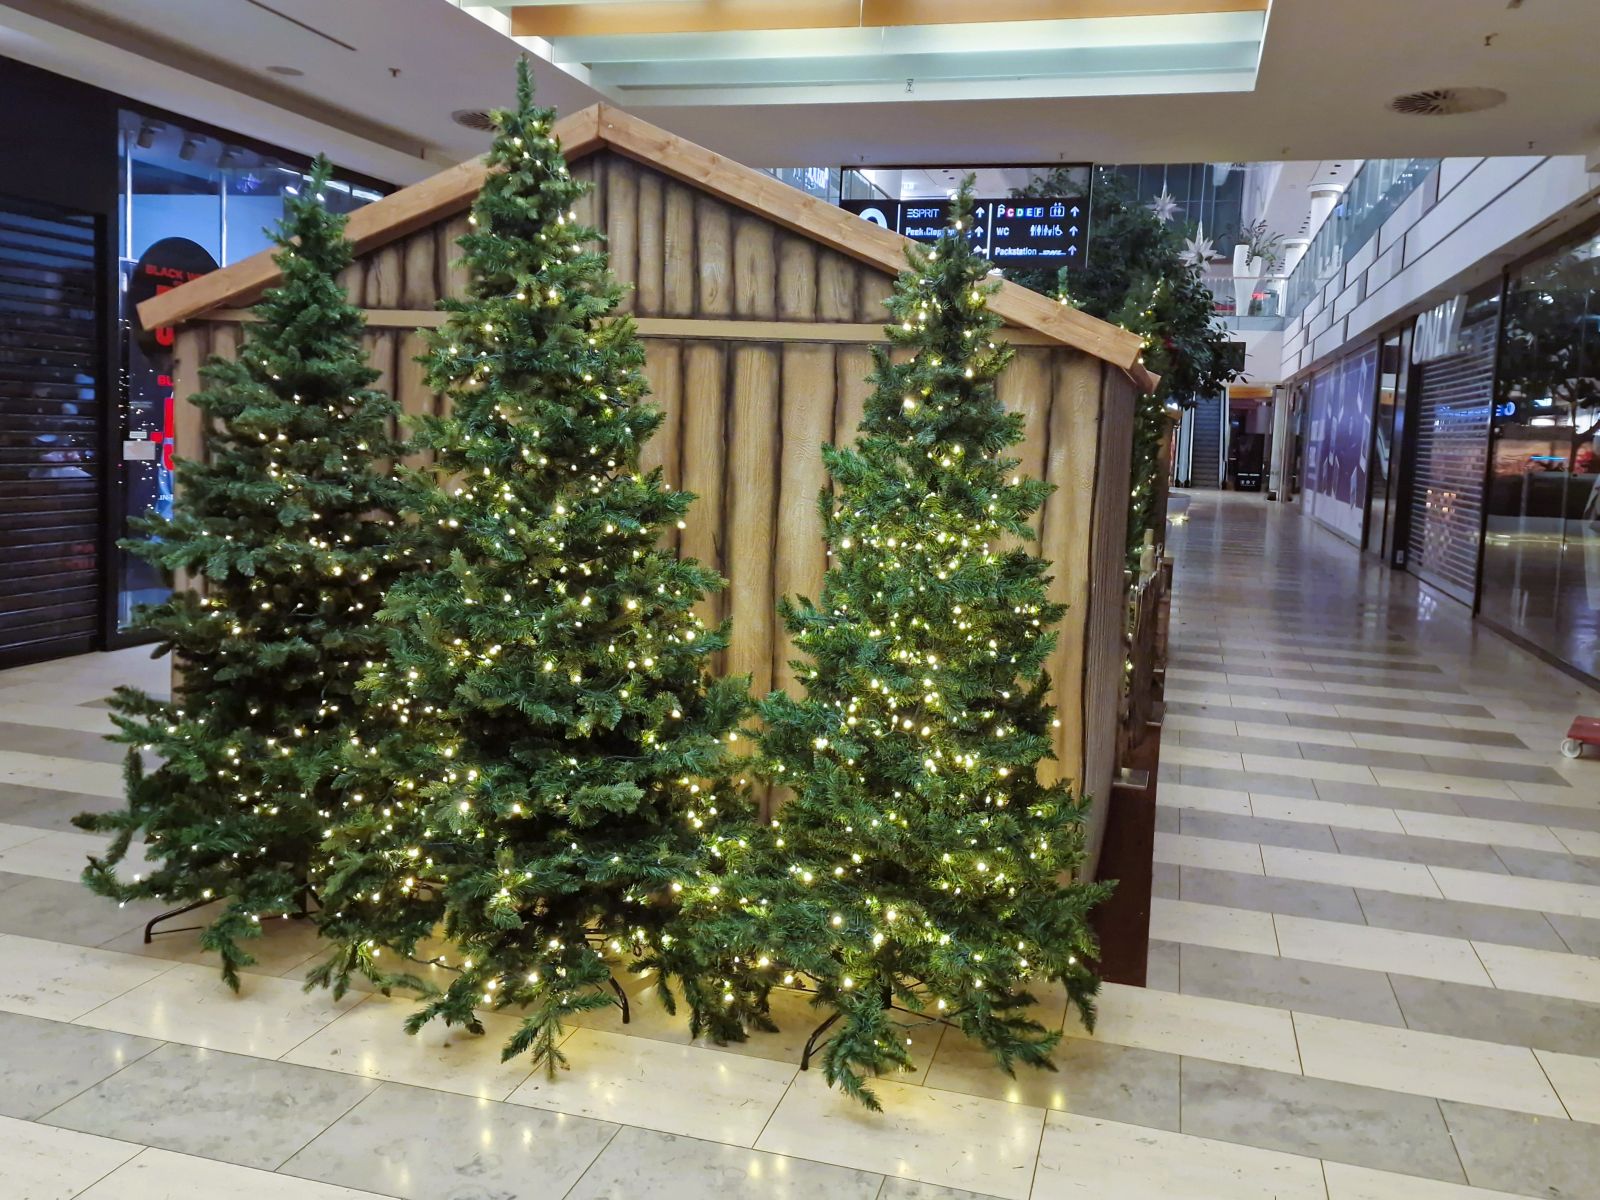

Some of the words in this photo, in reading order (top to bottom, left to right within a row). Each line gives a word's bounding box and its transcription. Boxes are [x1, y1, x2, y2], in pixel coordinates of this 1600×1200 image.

[906, 208, 940, 218] ESPRIT
[996, 226, 1010, 236] WC
[994, 246, 1038, 256] Packstation
[145, 264, 183, 279] BLACK
[1412, 295, 1463, 365] ONLY
